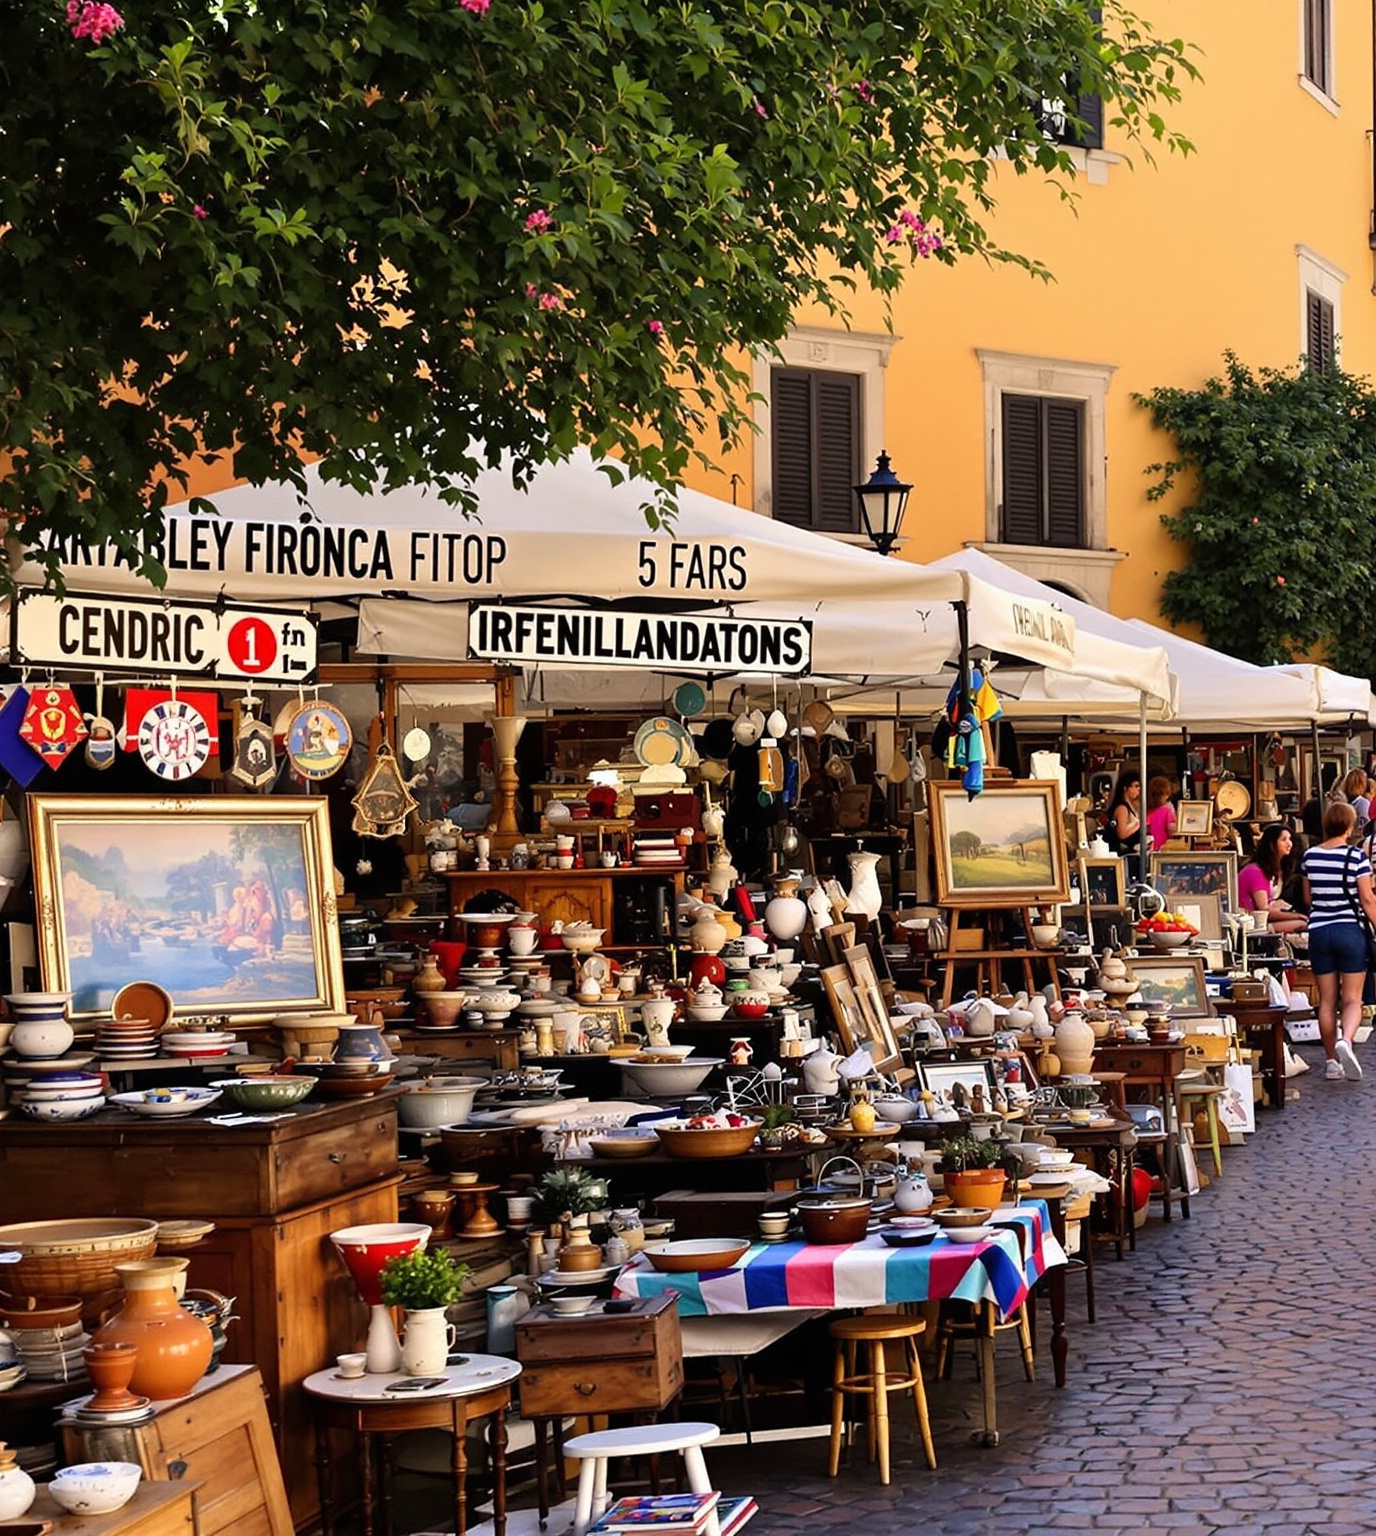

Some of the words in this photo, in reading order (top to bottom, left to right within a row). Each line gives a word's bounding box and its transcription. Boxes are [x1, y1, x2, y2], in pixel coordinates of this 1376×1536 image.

[410, 532, 507, 584] FITOP
[638, 541, 657, 587] 5
[670, 543, 747, 590] FARS
[59, 604, 204, 664] CENDRIC
[242, 626, 261, 666] 1
[478, 610, 803, 666] IRFENILLANDATONS
